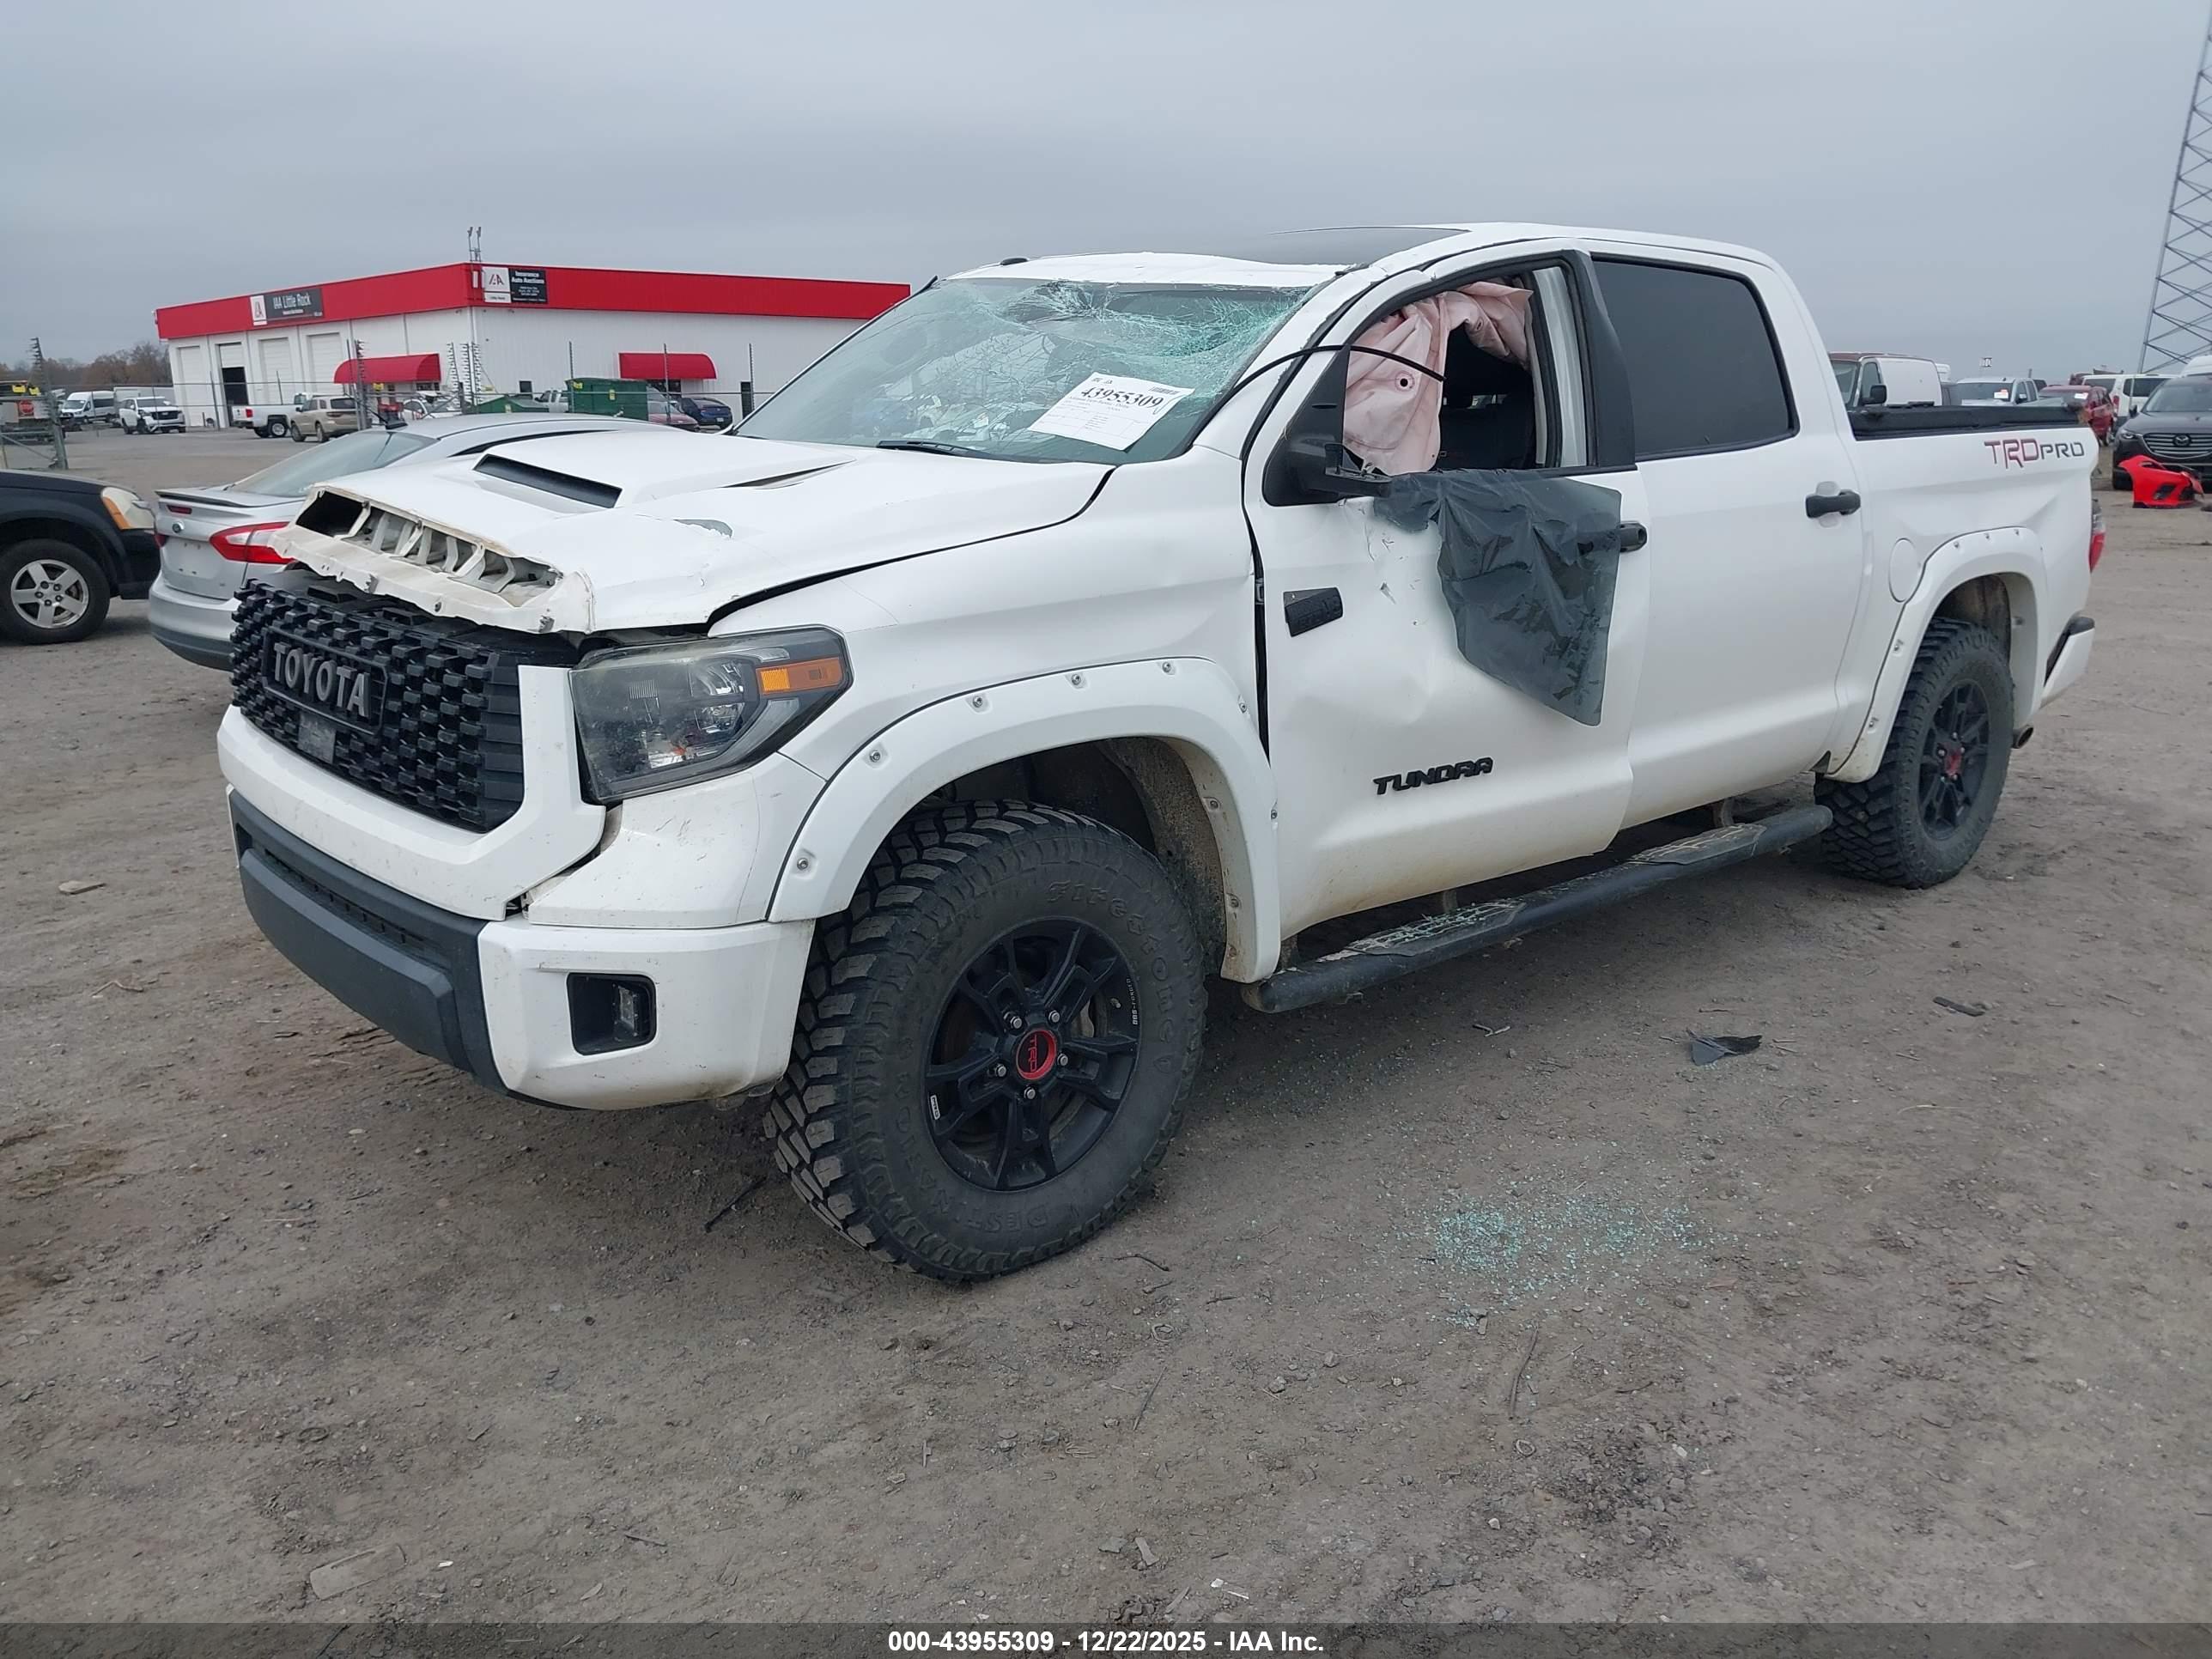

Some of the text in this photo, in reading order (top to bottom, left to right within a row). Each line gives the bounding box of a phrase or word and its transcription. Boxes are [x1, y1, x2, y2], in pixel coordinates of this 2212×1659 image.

[283, 295, 297, 308] Little
[296, 292, 312, 307] Rock
[1080, 386, 1164, 409] 43955309
[1984, 438, 2086, 470] TRD PRO
[273, 642, 371, 719] TOYOTA
[1372, 757, 1495, 796] TUNDRA
[1028, 1033, 1038, 1073] TRD
